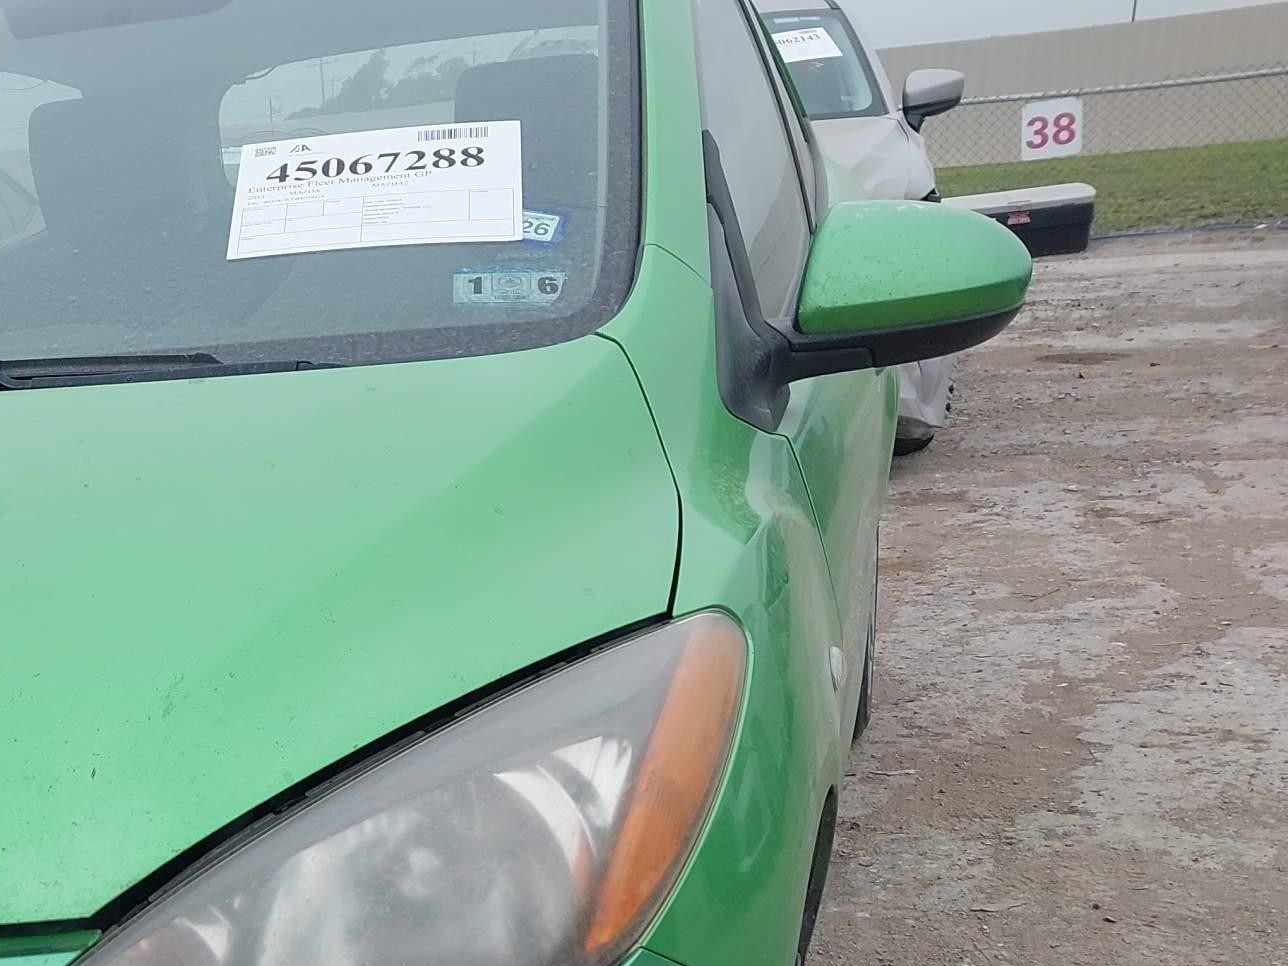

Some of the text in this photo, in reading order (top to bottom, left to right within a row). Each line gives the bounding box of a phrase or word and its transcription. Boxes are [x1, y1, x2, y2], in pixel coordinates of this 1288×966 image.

[1026, 112, 1076, 149] 38
[266, 146, 485, 183] 45067288
[248, 184, 303, 193] Enterprise
[308, 179, 333, 187] Fleet
[338, 173, 409, 184] Management
[523, 221, 551, 236] 26
[467, 276, 559, 295] 1 6
